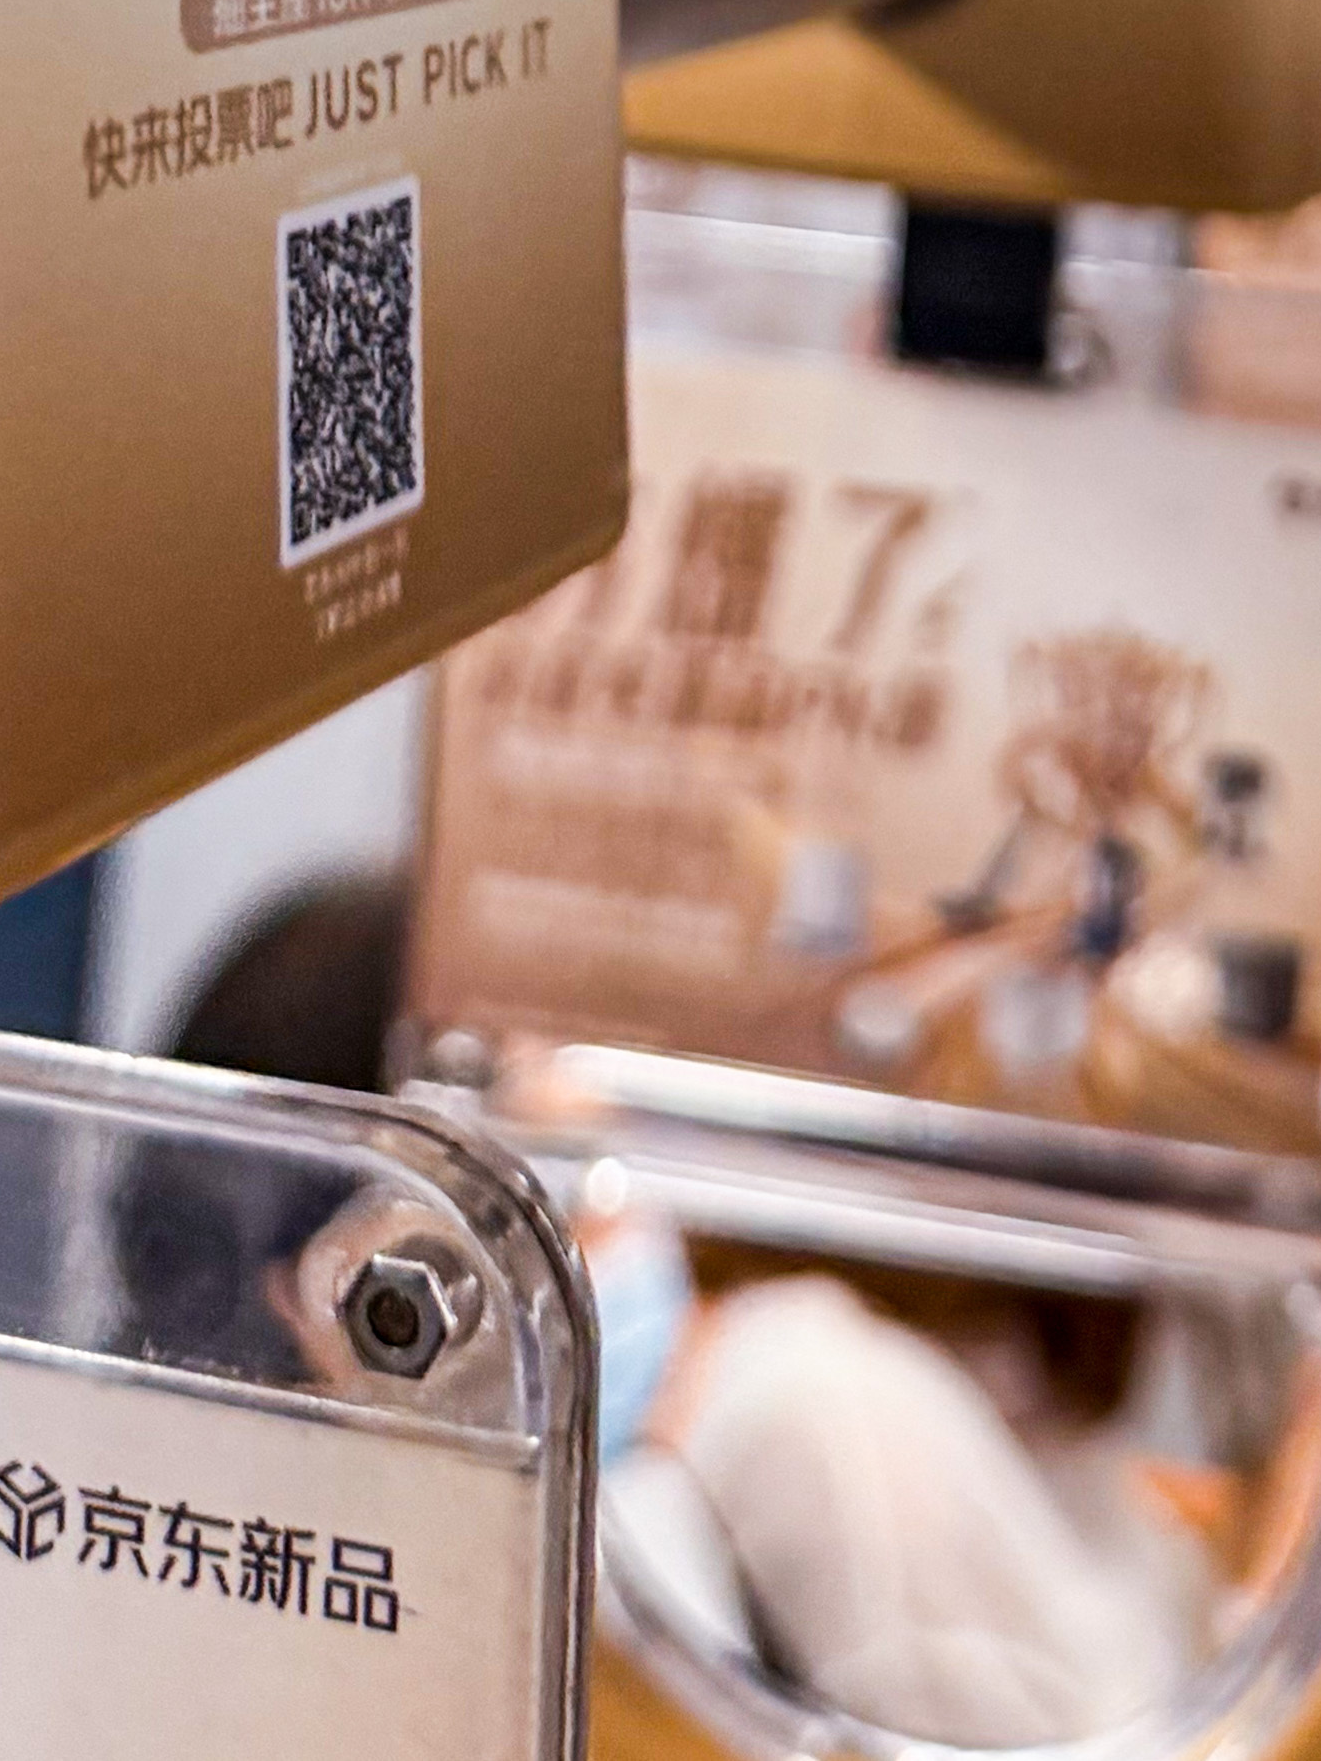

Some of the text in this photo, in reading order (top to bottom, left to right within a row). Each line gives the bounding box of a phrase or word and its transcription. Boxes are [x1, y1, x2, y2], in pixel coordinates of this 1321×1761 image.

[305, 53, 404, 141] JUST
[422, 29, 508, 107] PICK
[521, 17, 552, 79] IT
[78, 1484, 398, 1633] 京东新品
